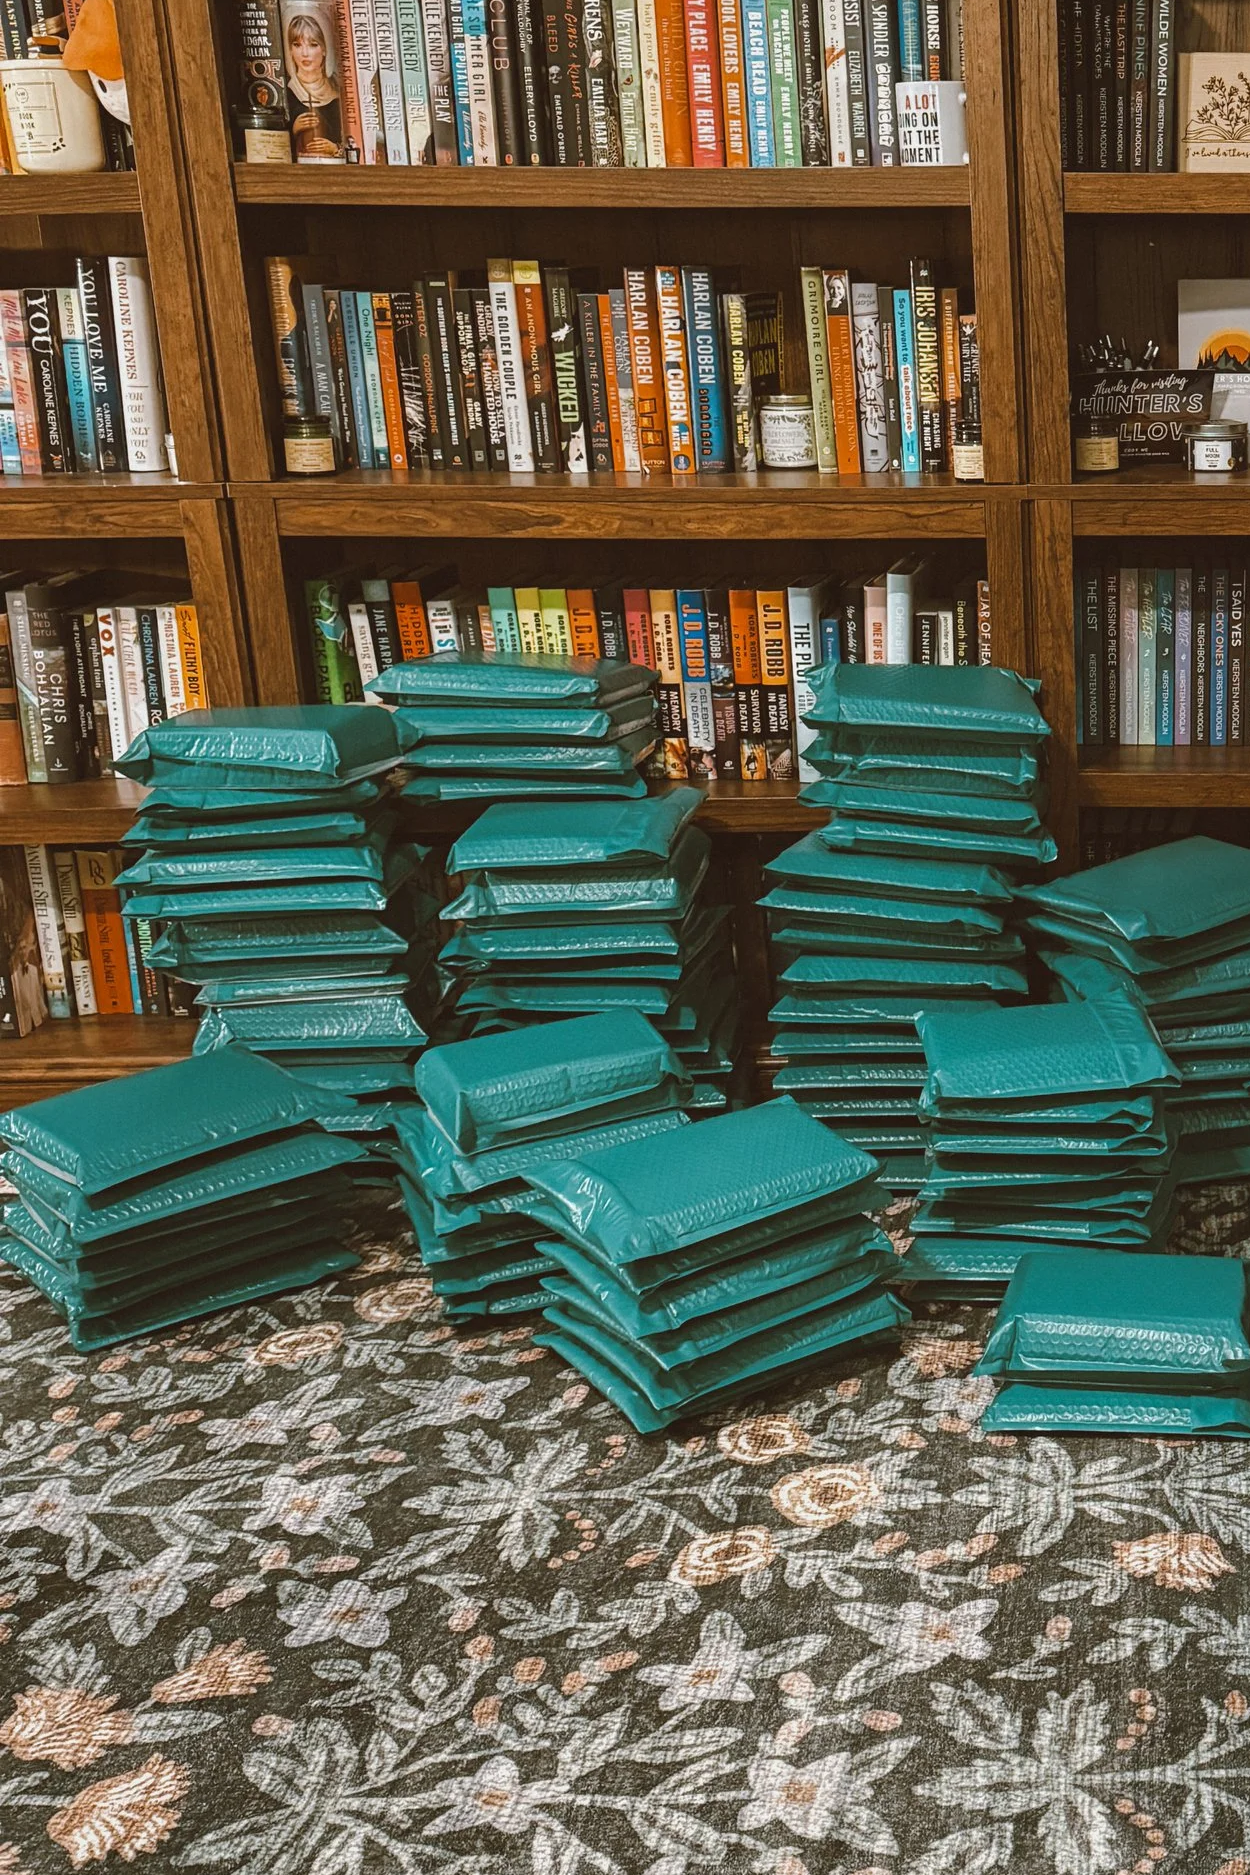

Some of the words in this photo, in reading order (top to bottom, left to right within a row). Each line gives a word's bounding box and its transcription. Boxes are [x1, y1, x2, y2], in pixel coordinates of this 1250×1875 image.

[489, 0, 510, 71] CLUB
[546, 15, 558, 53] BLEED
[615, 8, 635, 69] WEYWARD
[688, 12, 709, 52] PLACE
[748, 11, 765, 56] BEACH
[871, 4, 890, 58] SPINDLER
[926, 5, 941, 50] HORSE
[426, 24, 445, 73] KENNEDY
[722, 27, 739, 74] LOVERS
[454, 43, 470, 104] REPUTATION
[473, 74, 486, 104] GIRL
[524, 67, 535, 105] ELLERY
[692, 64, 712, 104] EMILY
[752, 60, 766, 95] READ
[848, 51, 863, 95] ELIZABETH
[1157, 42, 1169, 96] WOMEN
[434, 98, 451, 124] PLAY
[621, 92, 636, 125] EMILIA
[726, 82, 741, 116] EMILY
[755, 100, 766, 128] EMILY
[781, 87, 792, 118] EMILY
[916, 94, 937, 110] LOT
[526, 108, 537, 142] LLOYD
[624, 128, 639, 151] HART
[696, 109, 717, 151] HENRY
[729, 119, 743, 154] HENRY
[783, 122, 794, 156] HENRY
[852, 101, 866, 139] WARREN
[916, 130, 939, 145] THE
[921, 112, 938, 127] ON
[757, 130, 769, 158] HENRY
[116, 261, 131, 326] CAROLINE
[495, 291, 507, 311] THE
[628, 270, 649, 330] HARLAN
[692, 272, 712, 330] HARLAN
[915, 286, 935, 318] IRIS
[26, 296, 53, 355] YOU
[64, 295, 75, 336] KEPNES
[584, 312, 594, 343] KILLER
[661, 295, 684, 363] HARLAN
[729, 302, 744, 346] HARLAN
[808, 280, 822, 349] GRIMOIRE
[815, 354, 825, 384] GIRL
[122, 330, 138, 381] KEPNES
[498, 316, 513, 356] GOLDEN
[69, 345, 83, 396] HIDDEN
[92, 365, 108, 394] ME
[634, 335, 654, 385] COBEN
[696, 335, 715, 384] COBEN
[732, 350, 744, 385] COBEN
[916, 321, 940, 404] JOHANSEN
[40, 360, 55, 407] CAROLINE
[502, 360, 517, 400] COUPLE
[555, 351, 580, 423] WICKED
[665, 368, 689, 422] COBEN
[904, 385, 912, 410] about
[1092, 382, 1130, 397] Thanks
[1131, 379, 1149, 394] for
[1151, 374, 1189, 390] visiting
[699, 389, 712, 455] STRANGER
[1079, 393, 1204, 415] HUNTER'S
[46, 409, 60, 446] KEPNES
[932, 412, 941, 449] CHASING
[957, 600, 968, 640] Beneath
[1087, 606, 1098, 632] LIST
[1215, 598, 1224, 634] LUCKY
[1231, 590, 1242, 620] SAID
[98, 614, 116, 658] VOX
[141, 614, 156, 666] CHRISTINA
[604, 633, 617, 658] ROBB
[793, 623, 812, 649] THE
[1215, 637, 1224, 667] ONES
[1231, 622, 1242, 647] YES
[184, 641, 198, 674] FILTHY
[685, 638, 706, 678] ROBB
[765, 638, 785, 678] ROBB
[33, 650, 55, 746] BOHJALIAN
[50, 673, 68, 724] CHRIS
[146, 669, 159, 711] LAUREN
[188, 676, 202, 696] BOY
[1232, 658, 1240, 699] KIERSTEN
[669, 691, 681, 732] MEMORY
[691, 707, 700, 739] DEATH
[700, 687, 711, 743] CELEBRITY
[739, 703, 749, 732] DEATH
[750, 689, 762, 734] SURVIVOR
[769, 704, 778, 733] DEATH
[777, 694, 788, 732] FANTASY
[1231, 700, 1240, 739] MODGLIN
